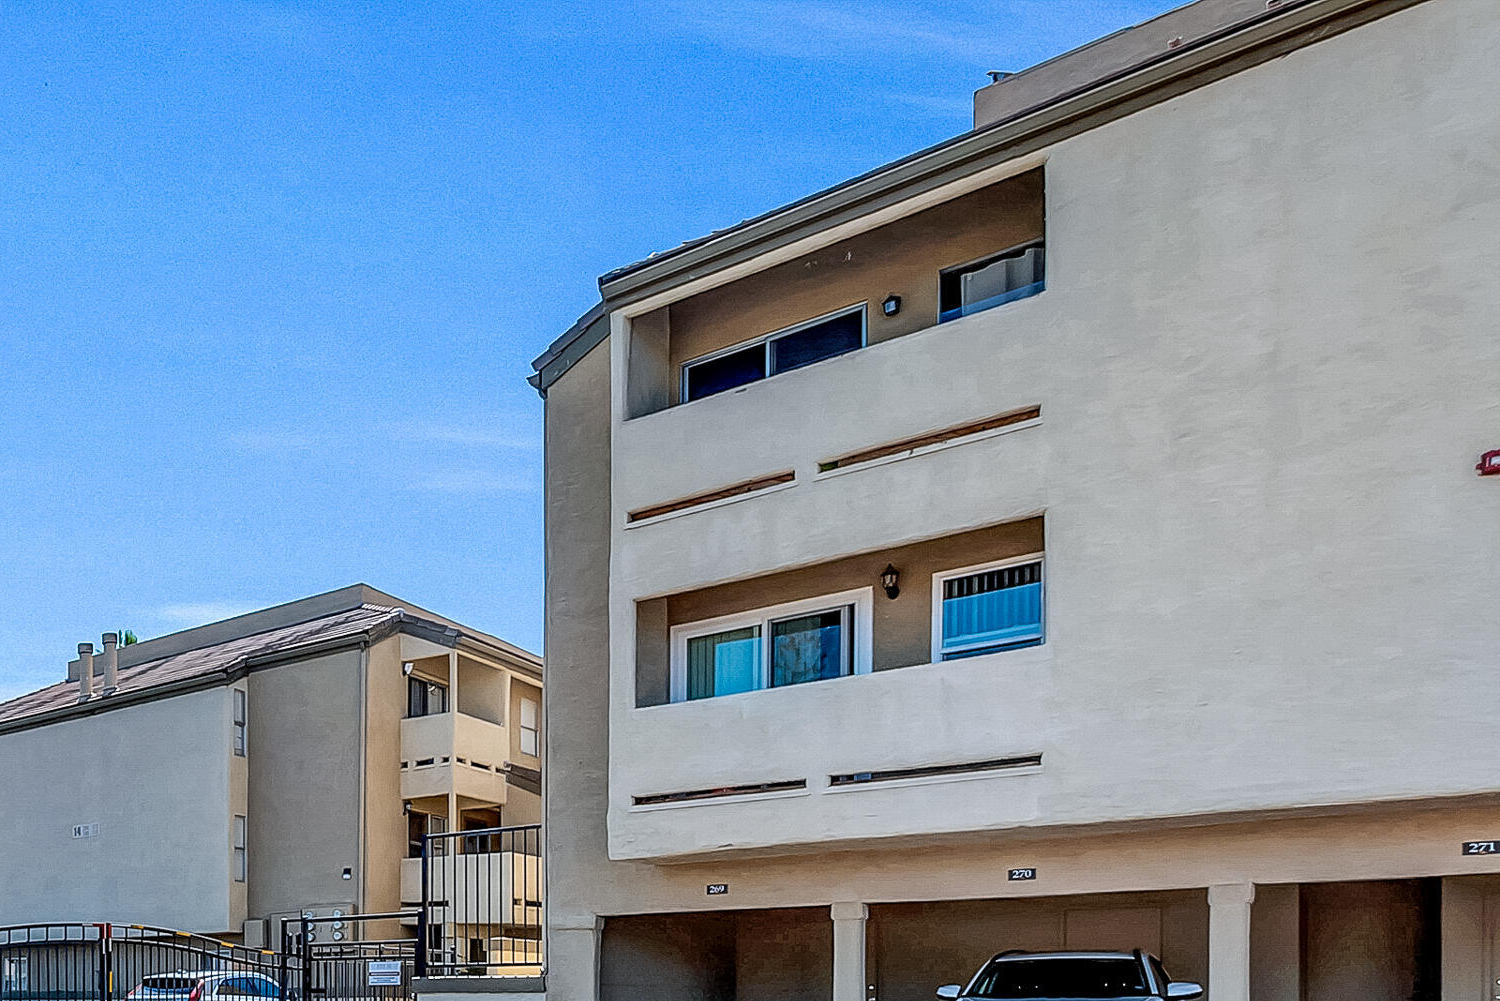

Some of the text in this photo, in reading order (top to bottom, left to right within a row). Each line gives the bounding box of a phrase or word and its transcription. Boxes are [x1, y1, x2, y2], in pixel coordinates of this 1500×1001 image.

[1468, 842, 1496, 853] 271
[1012, 869, 1032, 879] 270
[709, 885, 725, 894] 269
